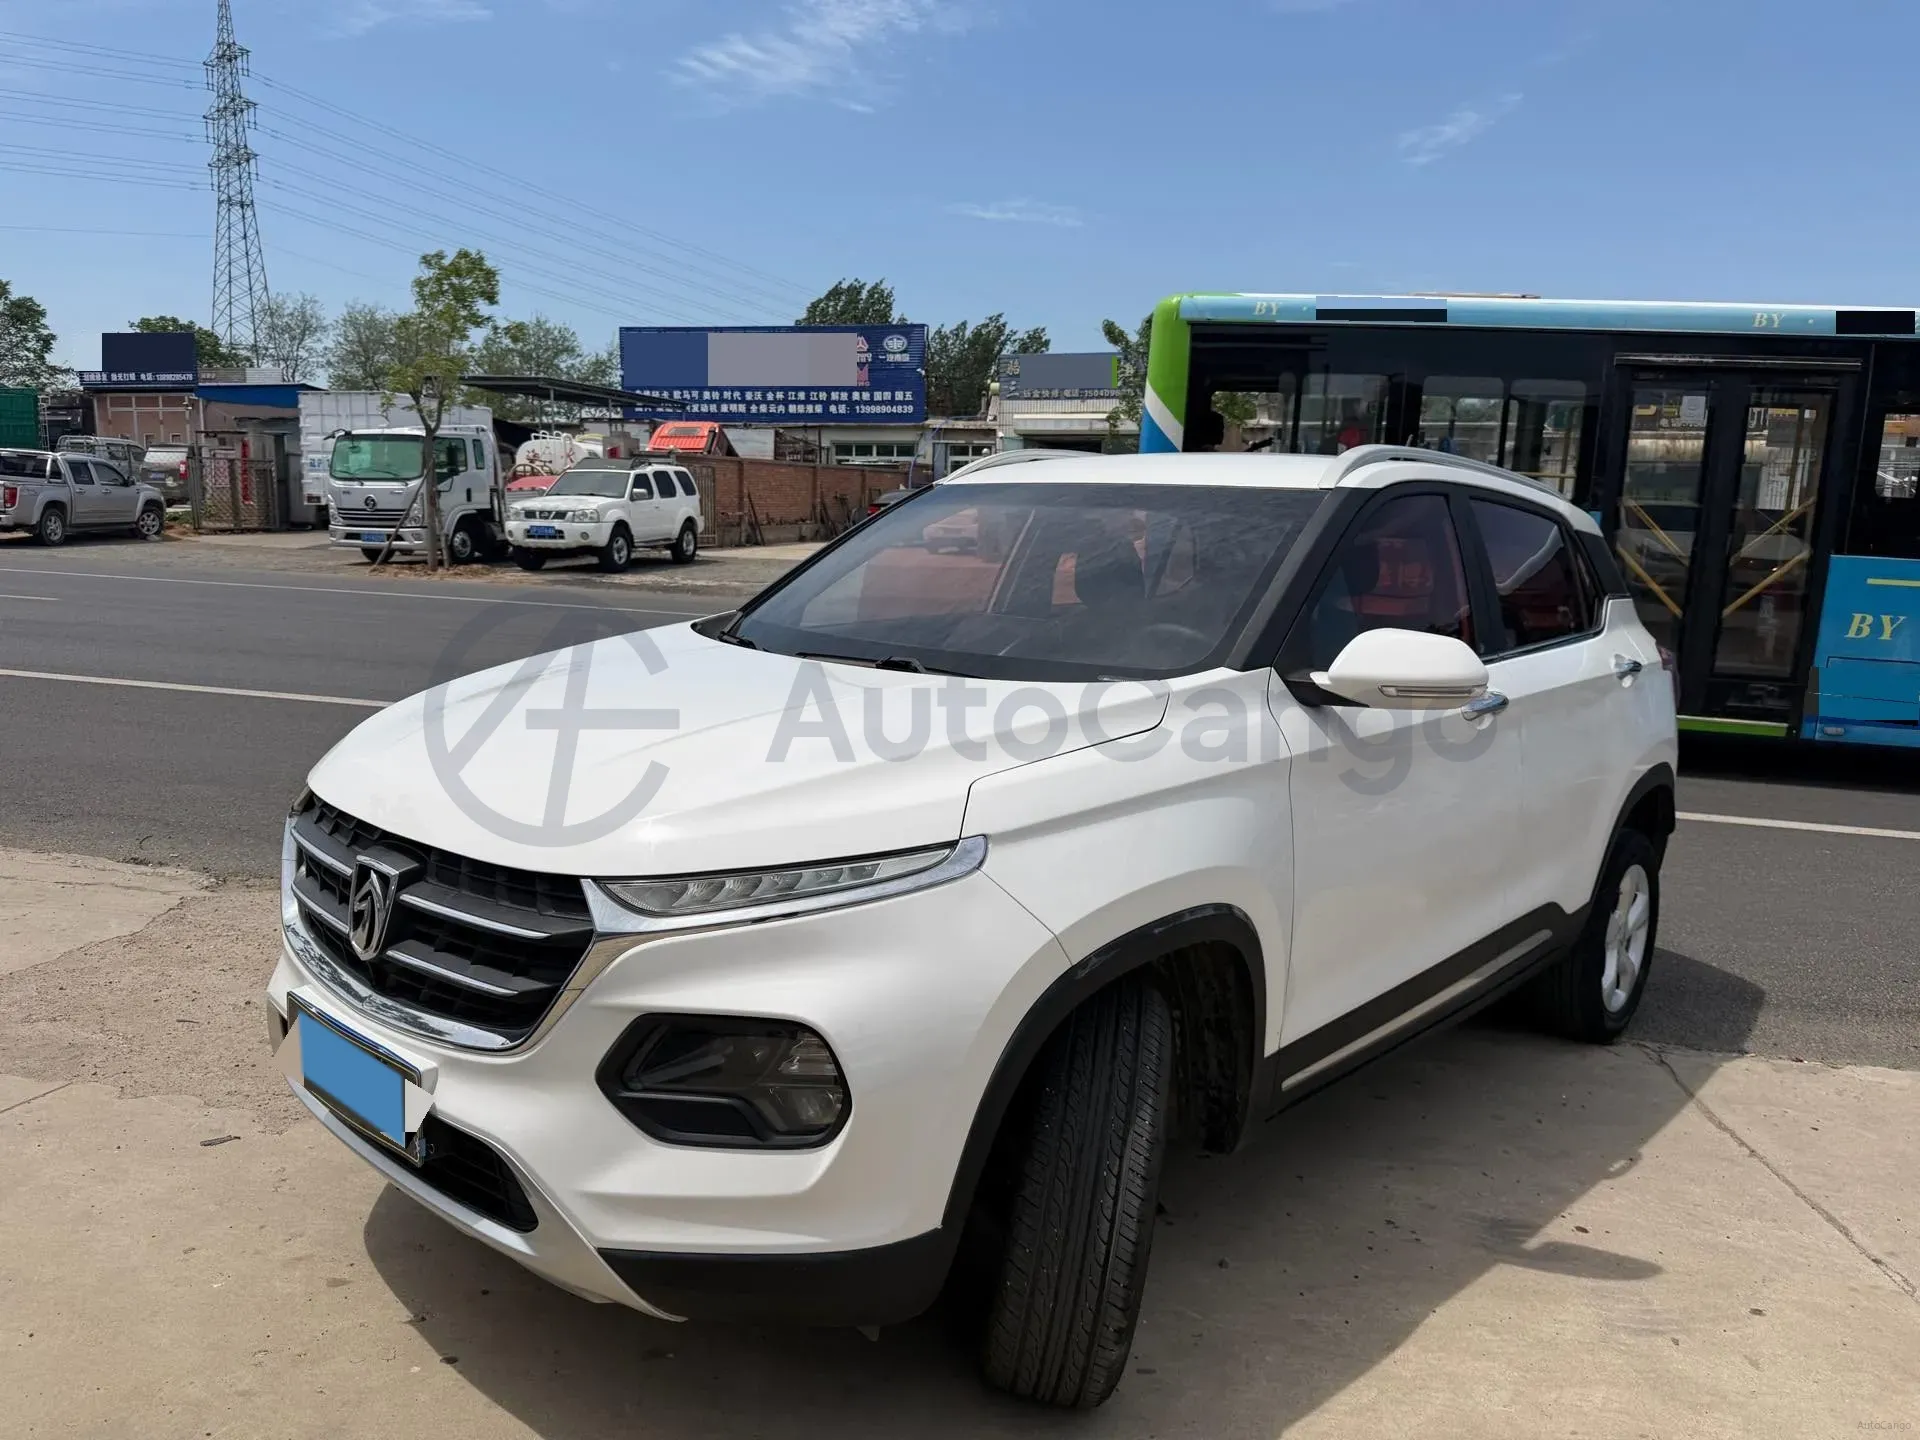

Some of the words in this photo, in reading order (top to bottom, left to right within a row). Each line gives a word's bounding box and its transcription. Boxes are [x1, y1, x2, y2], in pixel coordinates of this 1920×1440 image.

[1253, 301, 1281, 316] BY
[1752, 311, 1786, 329] BY
[722, 390, 742, 400] 时代
[766, 391, 785, 401] 金杯
[809, 391, 828, 401] 江铃
[895, 391, 913, 401] 国五
[720, 403, 747, 413] 康明斯
[1844, 612, 1908, 641] BY
